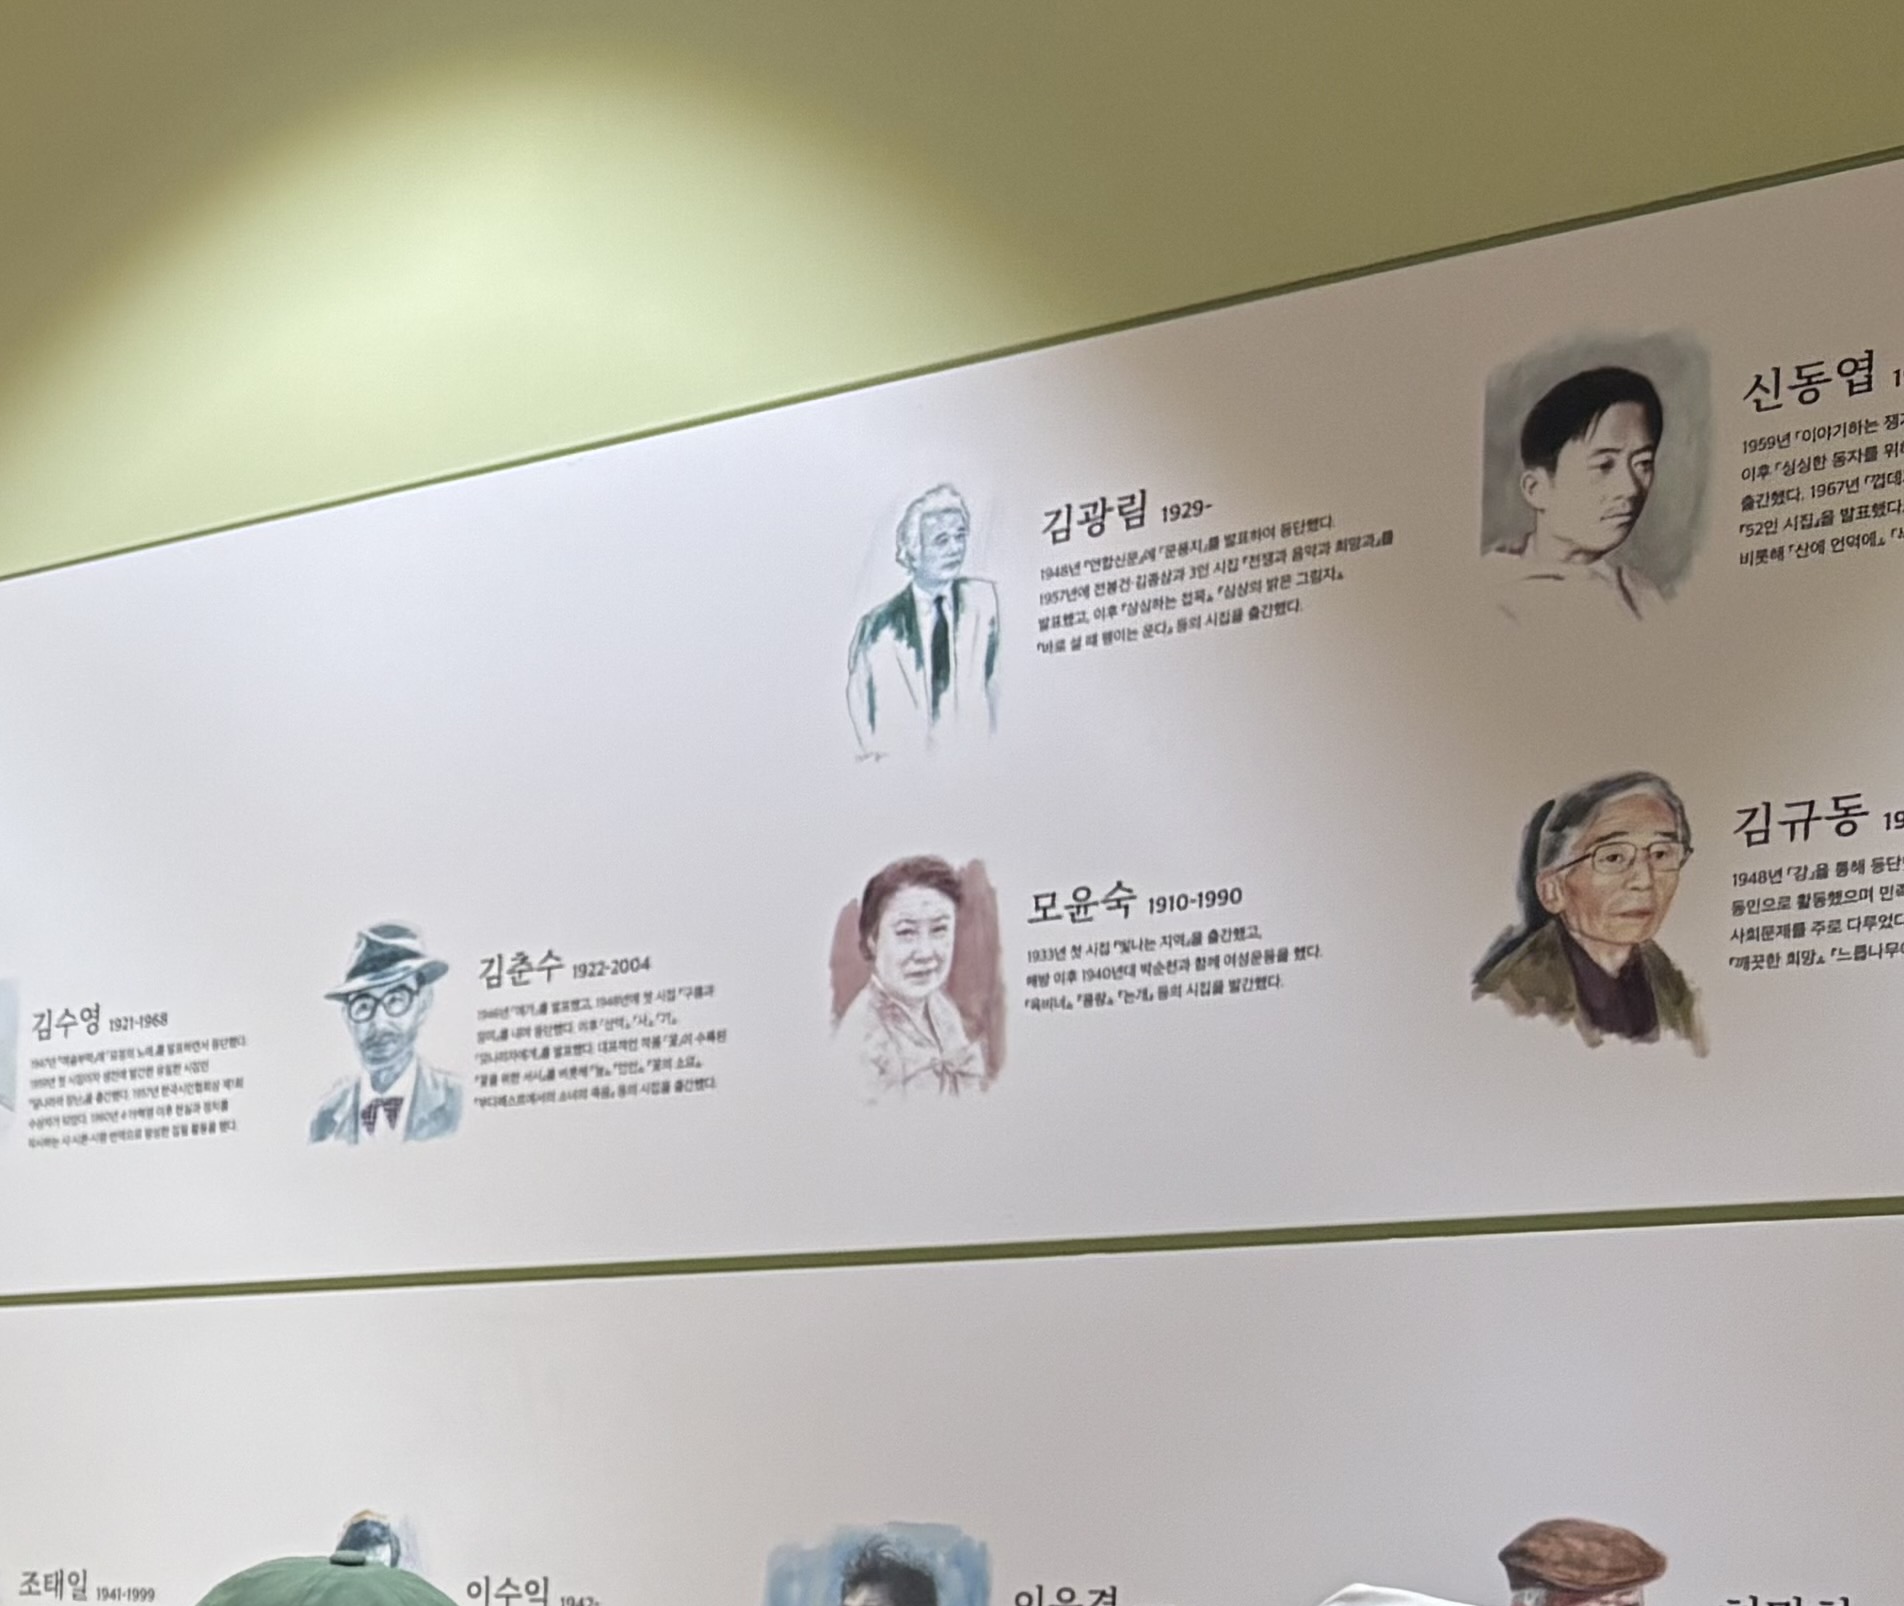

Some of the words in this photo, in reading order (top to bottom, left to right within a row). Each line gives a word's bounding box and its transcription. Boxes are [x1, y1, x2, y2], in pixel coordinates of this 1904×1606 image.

[1743, 349, 1874, 413] 신동엽
[1743, 431, 1791, 455] 1959년
[1741, 463, 1769, 483] 이후
[1811, 476, 1859, 499] 1967년
[1042, 489, 1147, 545] 김광림
[1161, 500, 1214, 523] 1929-
[1224, 524, 1276, 549] 발표하여
[1740, 545, 1784, 567] 비롯해
[1040, 583, 1090, 606] 1957년에
[1190, 561, 1209, 581] 3인
[1214, 556, 1239, 576] 시집
[1094, 603, 1117, 621] 이후
[1177, 614, 1201, 634] 등의
[1206, 606, 1243, 627] 시집을
[1733, 793, 1870, 848] 김규동
[1733, 867, 1782, 888] 1948년
[1836, 858, 1865, 879] 통해
[1027, 880, 1137, 924] 모윤숙
[1148, 887, 1243, 915] 1910-1990
[1732, 894, 1791, 918] 동인으로
[1797, 886, 1873, 911] 활동했으며
[1730, 921, 1806, 944] 사회문제를
[1811, 918, 1842, 937] 주로
[1071, 943, 1082, 961] 첫
[1086, 940, 1110, 958] 시집
[479, 949, 565, 990] 김춘수
[572, 956, 651, 980] 1922-2004
[1054, 968, 1077, 985] 이후
[1195, 953, 1220, 972] 함께
[1158, 983, 1182, 1002] 등의
[1187, 979, 1224, 998] 시집을
[32, 1002, 100, 1041] 김수영
[109, 1011, 168, 1032] 1921-1968
[18, 1568, 88, 1601] 조태일
[96, 1586, 155, 1602] 1941-1999
